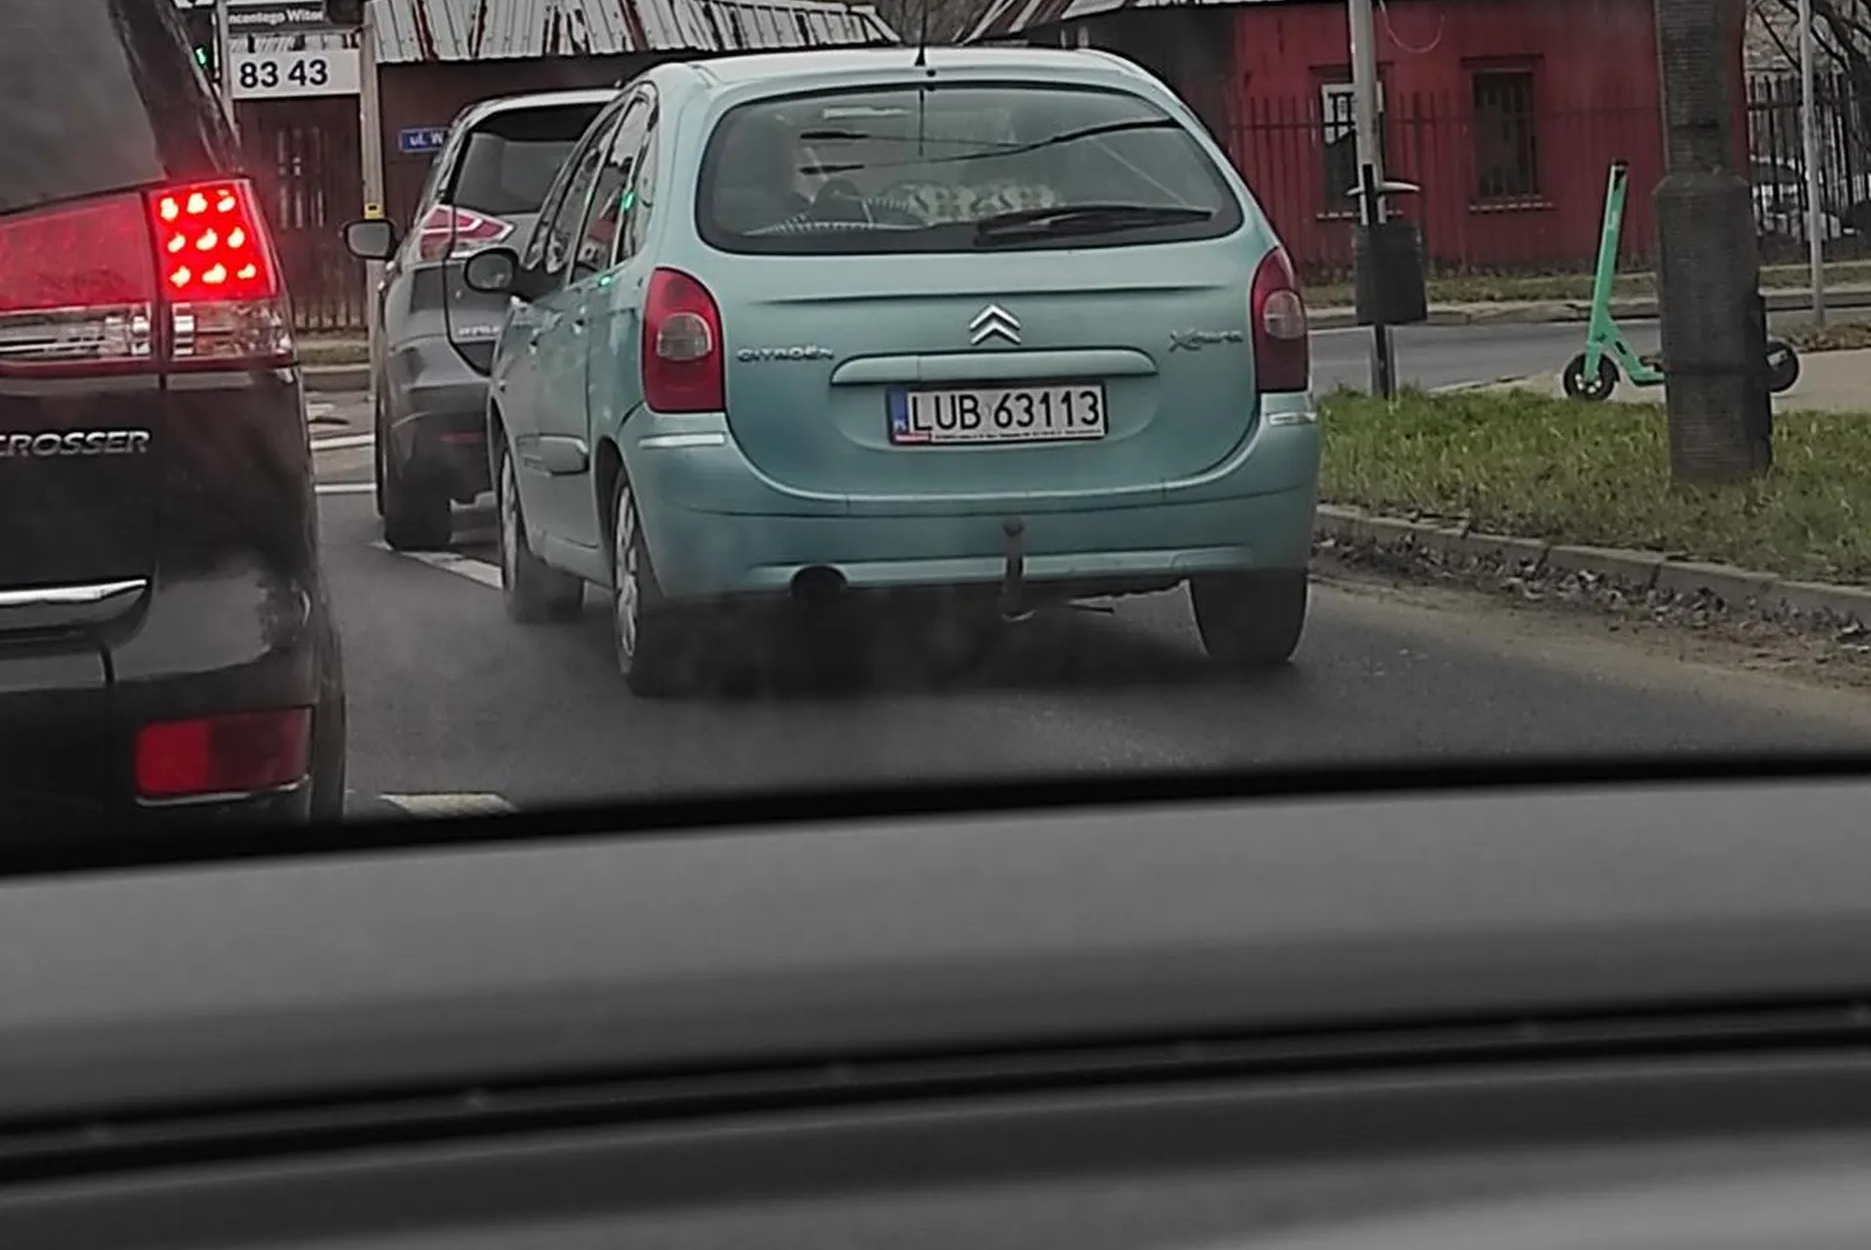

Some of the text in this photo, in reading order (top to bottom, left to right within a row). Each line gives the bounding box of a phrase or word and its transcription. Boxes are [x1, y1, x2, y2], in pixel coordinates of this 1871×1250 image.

[239, 60, 328, 88] 83 43
[911, 390, 1099, 431] LUB 63113
